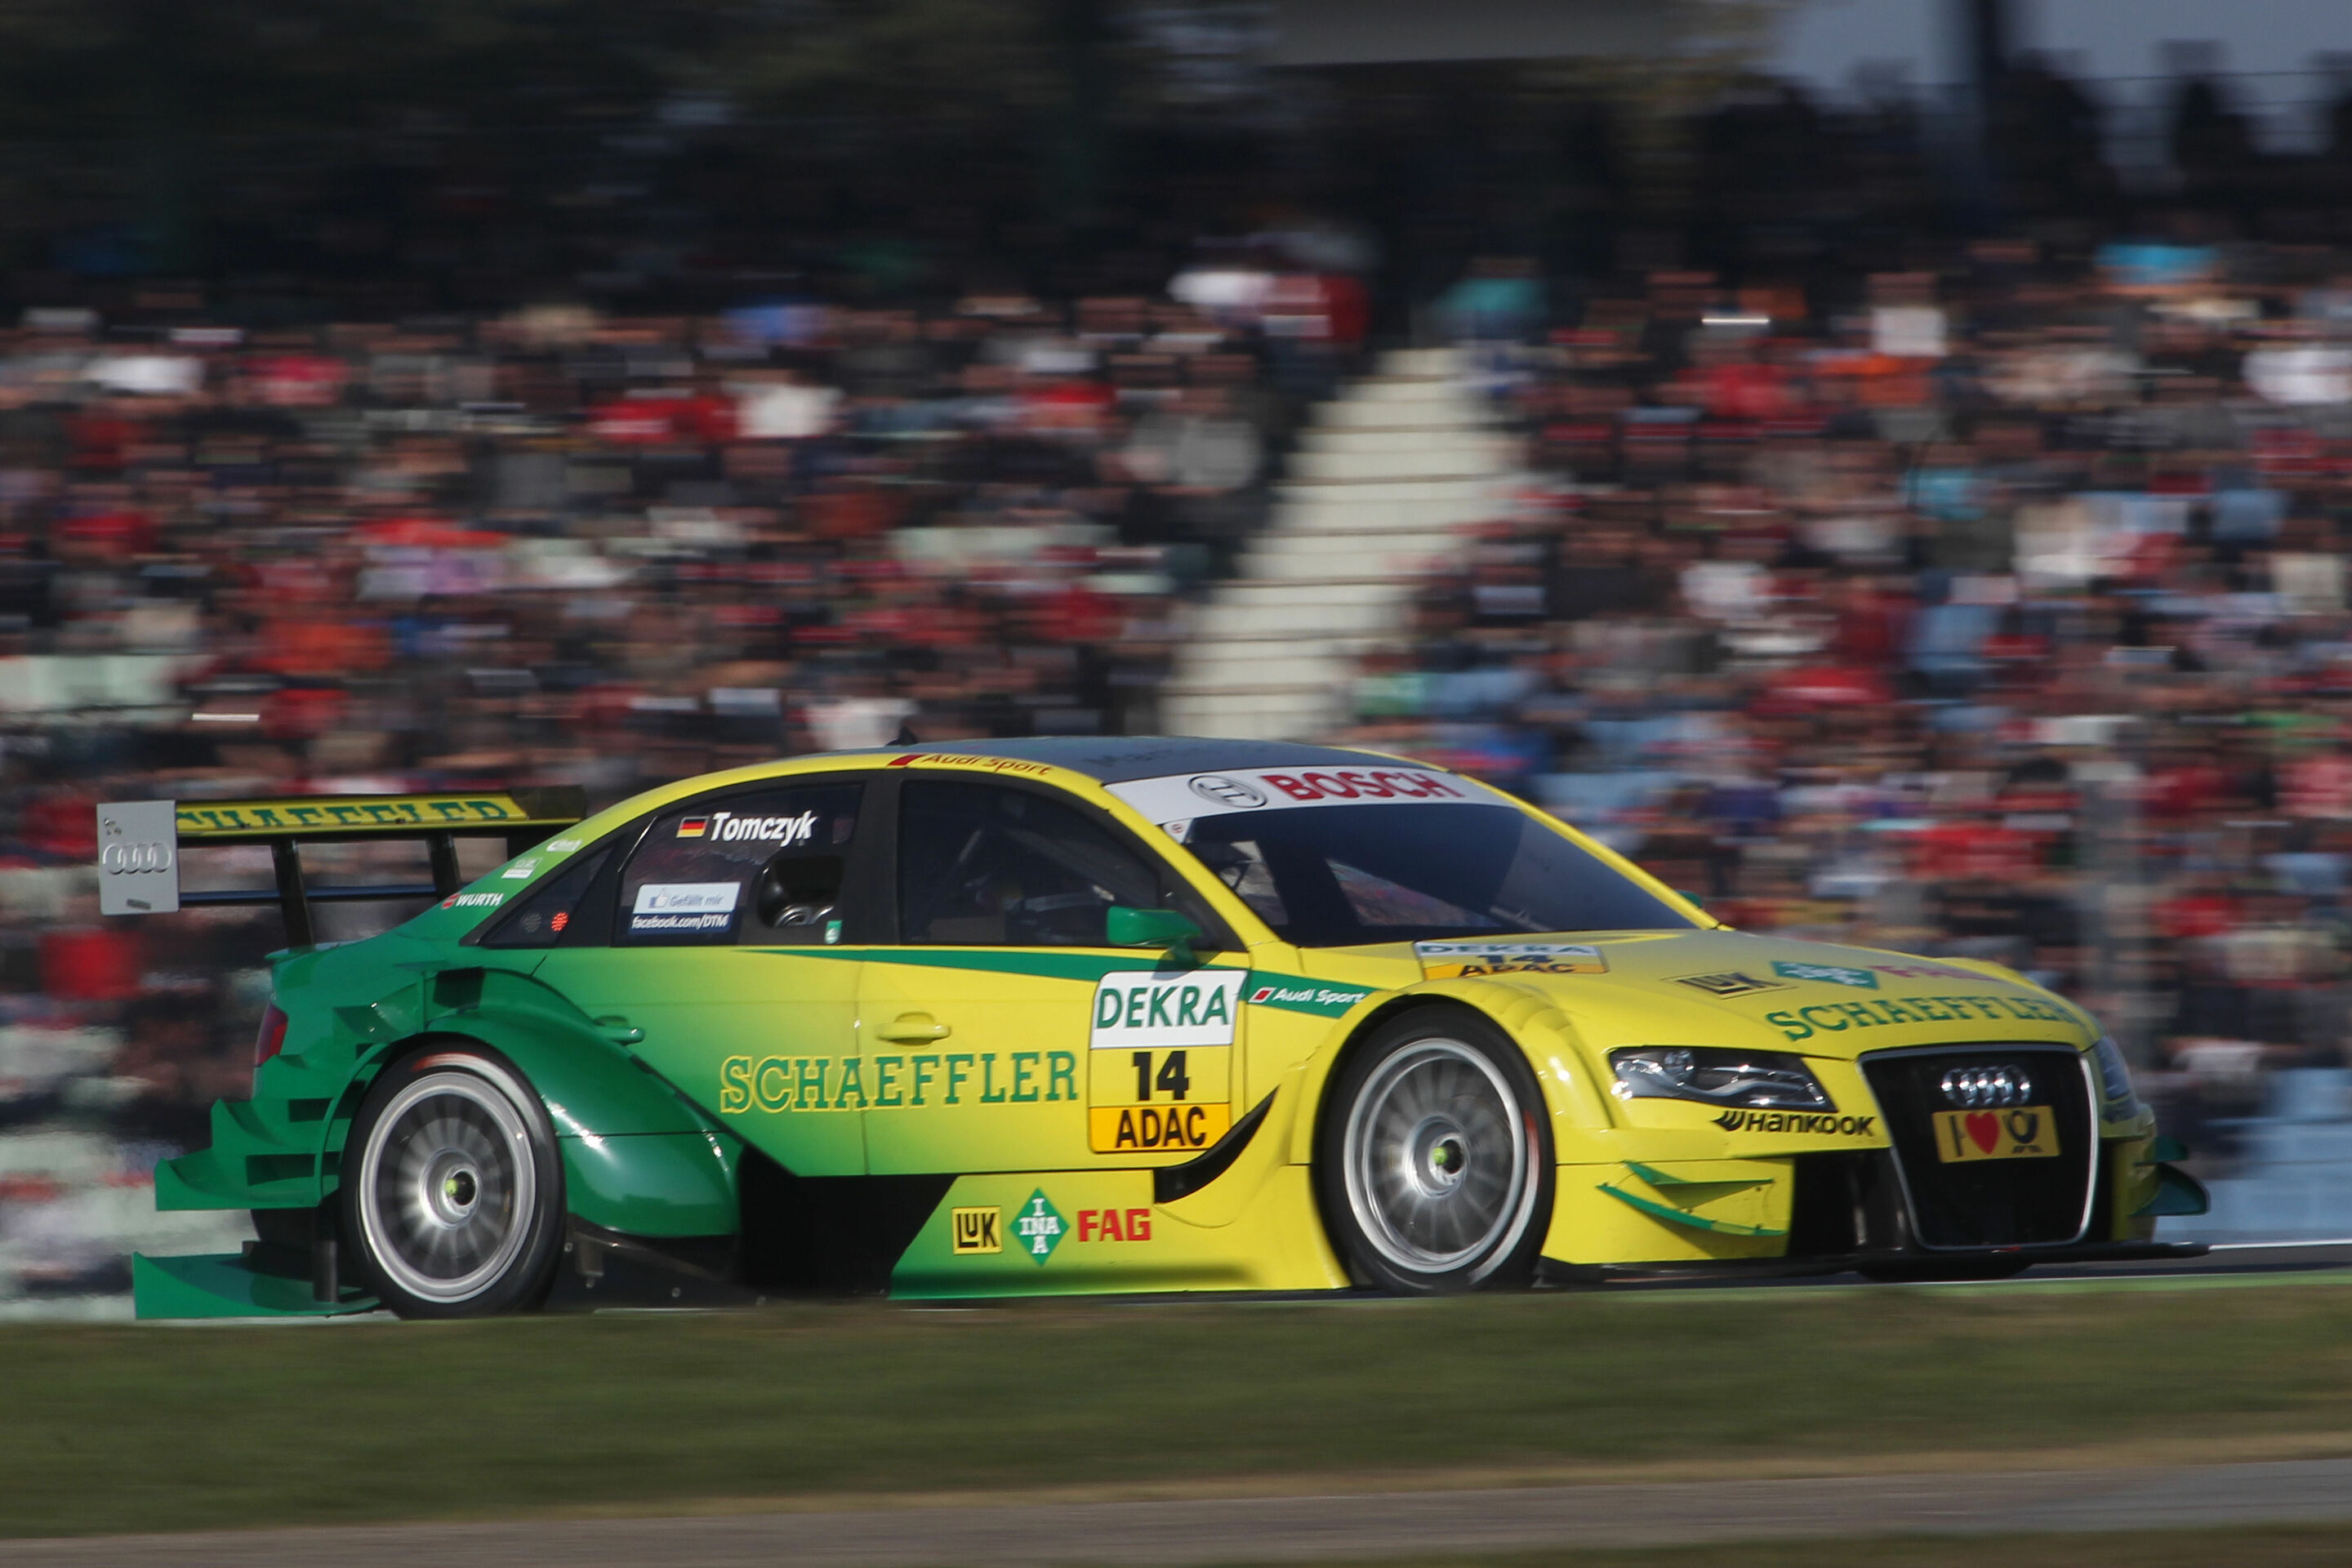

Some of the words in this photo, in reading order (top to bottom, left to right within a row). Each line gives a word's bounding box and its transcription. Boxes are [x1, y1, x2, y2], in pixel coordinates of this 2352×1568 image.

[921, 753, 980, 765] Audi
[982, 756, 1053, 776] Sport
[1260, 770, 1465, 801] BOSCH
[710, 810, 817, 848] Tomczyk
[631, 914, 730, 930] facebook.com/DTM
[1420, 945, 1592, 954] DEKRA
[1097, 985, 1227, 1029] DEKRA
[1272, 987, 1316, 1001] Audi
[1315, 989, 1365, 1005] Sport
[720, 1051, 1078, 1113] SCHAEFFLER
[1133, 1050, 1190, 1102] 14
[1116, 1107, 1206, 1148] ADAC
[1078, 1209, 1152, 1242] FAG
